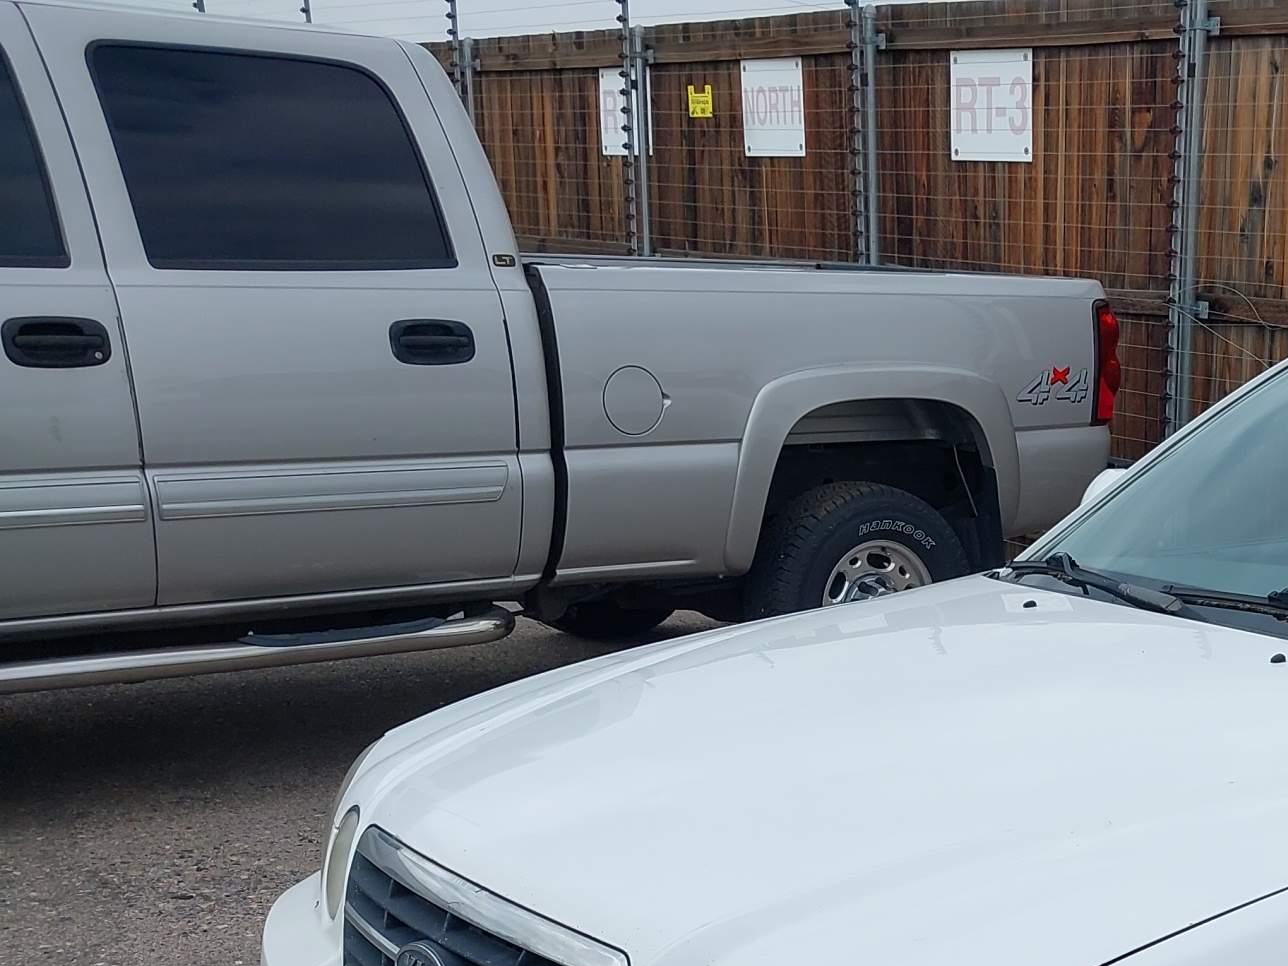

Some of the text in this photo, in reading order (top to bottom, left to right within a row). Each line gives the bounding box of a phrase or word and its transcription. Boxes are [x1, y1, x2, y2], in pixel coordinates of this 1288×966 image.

[744, 85, 802, 126] NORTH
[956, 77, 1028, 135] RT-3
[495, 255, 513, 265] LT
